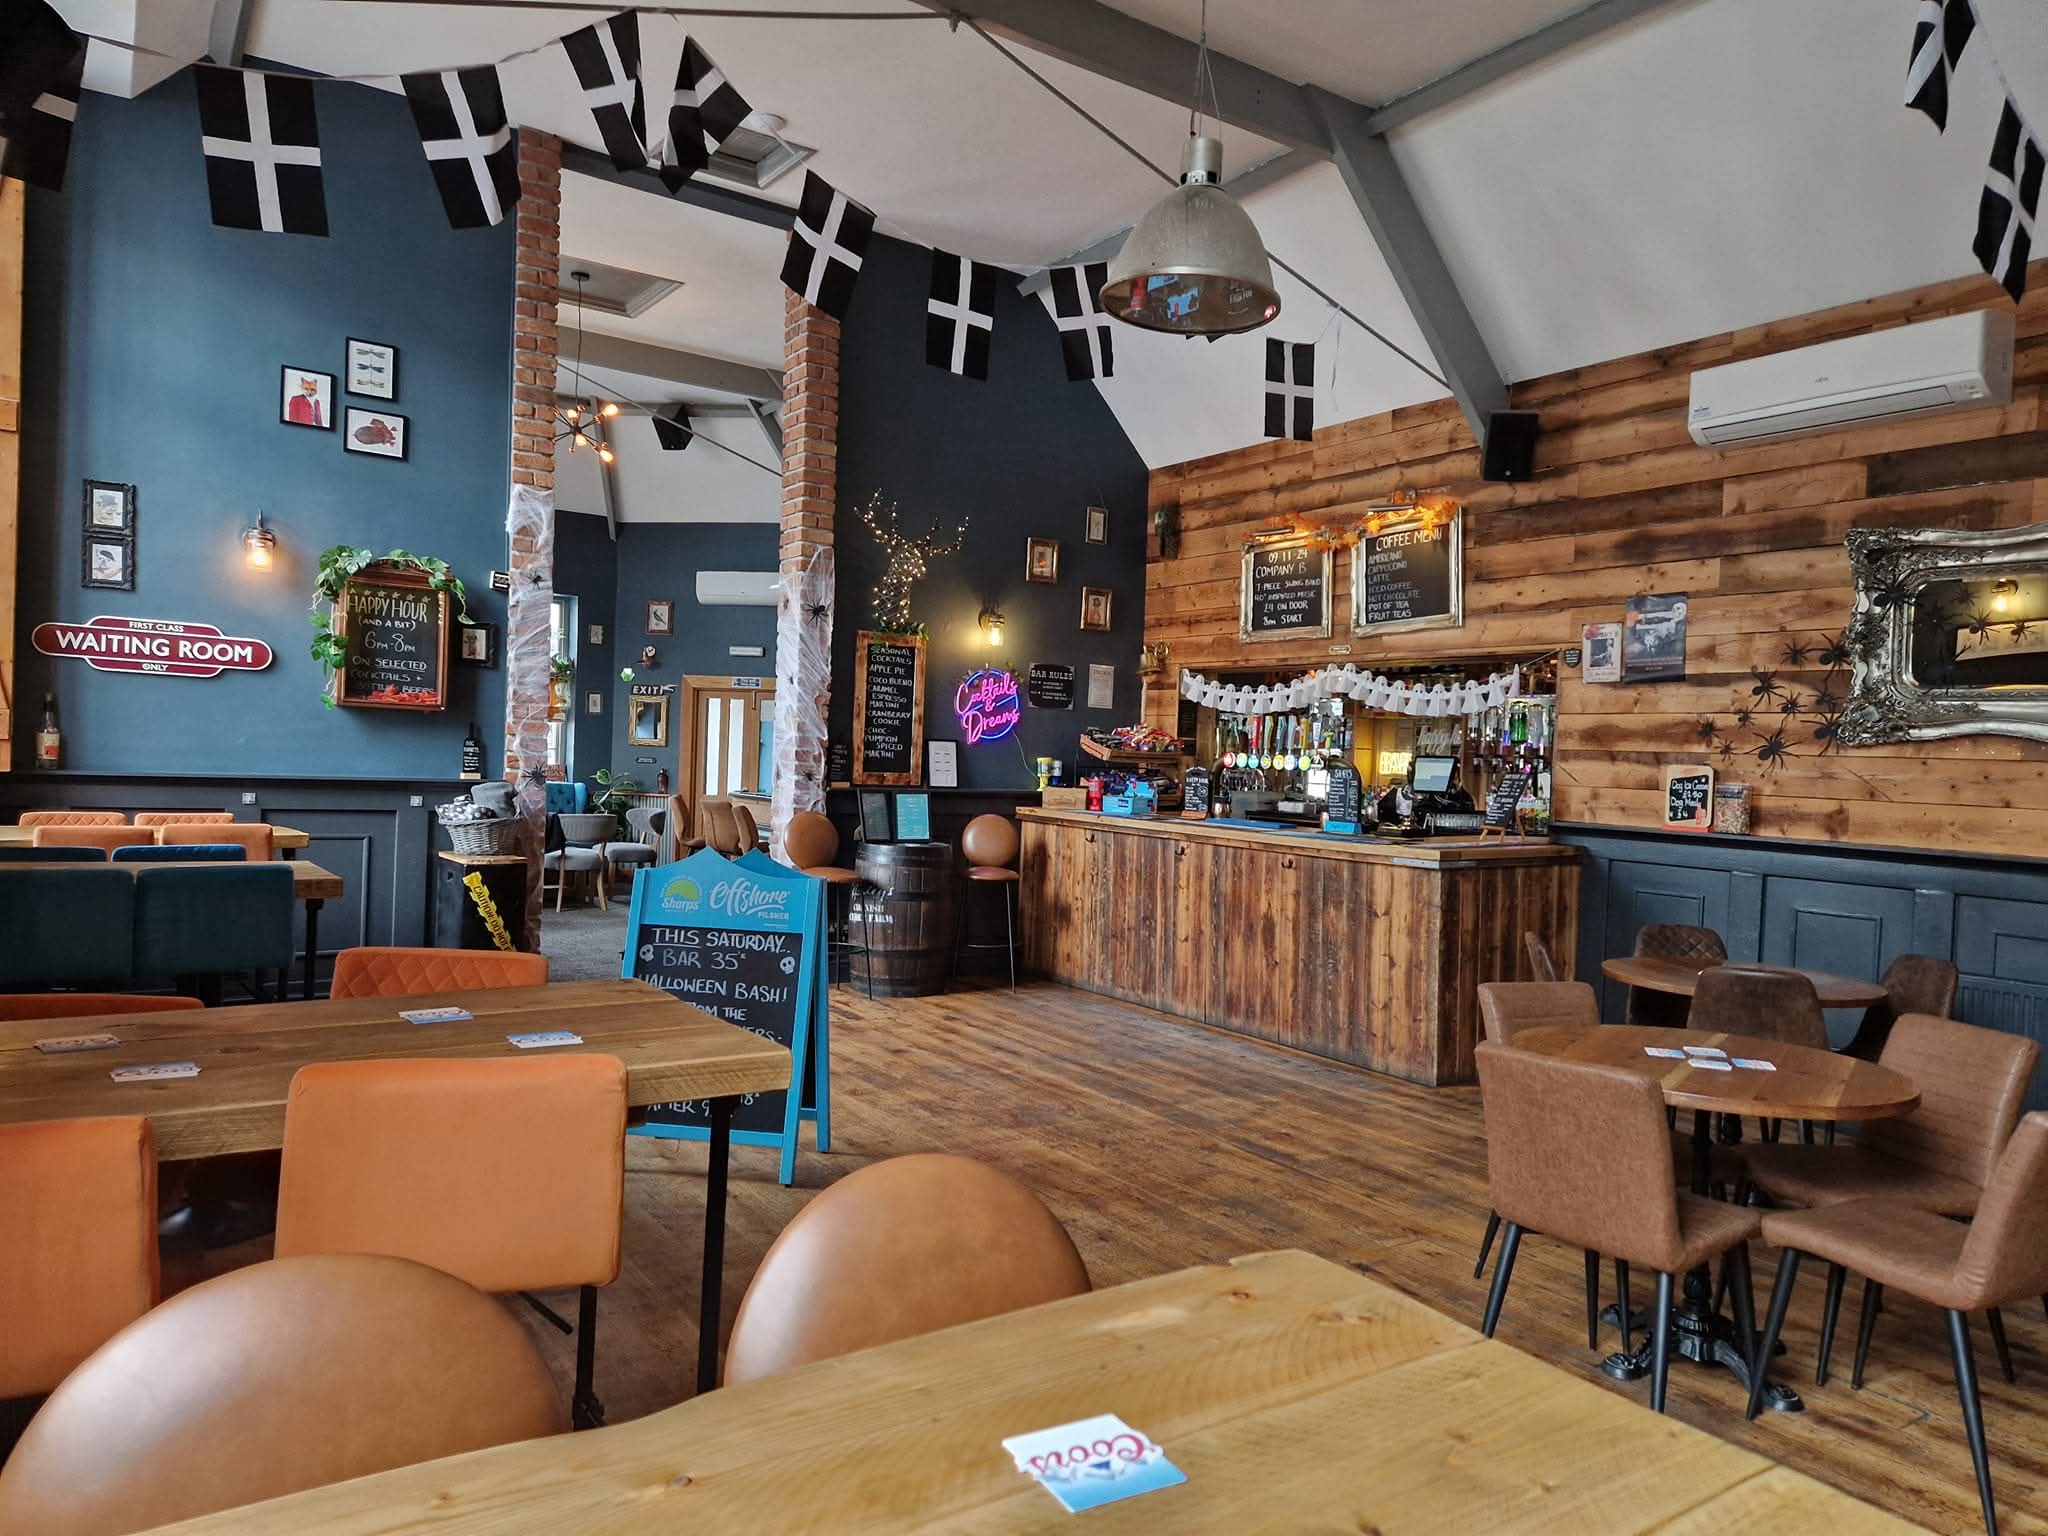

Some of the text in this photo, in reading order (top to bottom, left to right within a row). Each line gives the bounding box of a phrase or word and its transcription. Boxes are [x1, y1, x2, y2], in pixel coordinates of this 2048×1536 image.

[1376, 527, 1443, 552] COFFEE MENU
[1368, 550, 1403, 565] AMERICANO
[1255, 563, 1295, 579] COMPANY
[1368, 573, 1391, 585] LATTE
[347, 595, 428, 623] HAPPY HOUR
[1288, 600, 1308, 610] DOOR
[1368, 600, 1410, 612] POT OF TEA
[1280, 614, 1303, 625] START
[1368, 609, 1412, 622] FRUIT TEAS
[129, 621, 185, 633] FIRST CLASS
[394, 620, 416, 632] BIT)
[55, 630, 254, 664] WAITING ROOM
[352, 656, 427, 671] ON SELECTED
[871, 655, 912, 665] COCKTAILS
[142, 663, 169, 673] ONLY
[870, 663, 905, 675] APPLE PIE
[351, 669, 411, 682] COCKTAILS
[1031, 669, 1073, 681] BAR RULES
[633, 685, 658, 695] EXIT
[956, 672, 1019, 715] Cocktails
[984, 699, 996, 713] &
[868, 710, 911, 719] CRANBERRY
[963, 709, 1020, 744] Dreams
[864, 735, 898, 743] PUMPKIN
[875, 742, 903, 751] SPICED
[864, 749, 894, 760] MARTINI
[709, 877, 788, 917] Offshore
[758, 911, 790, 920] PILSNER
[652, 927, 700, 945] THIS
[663, 950, 701, 969] BAR
[734, 983, 788, 1003] BASH!
[722, 1006, 748, 1021] THE
[1027, 1433, 1146, 1476] Coors
